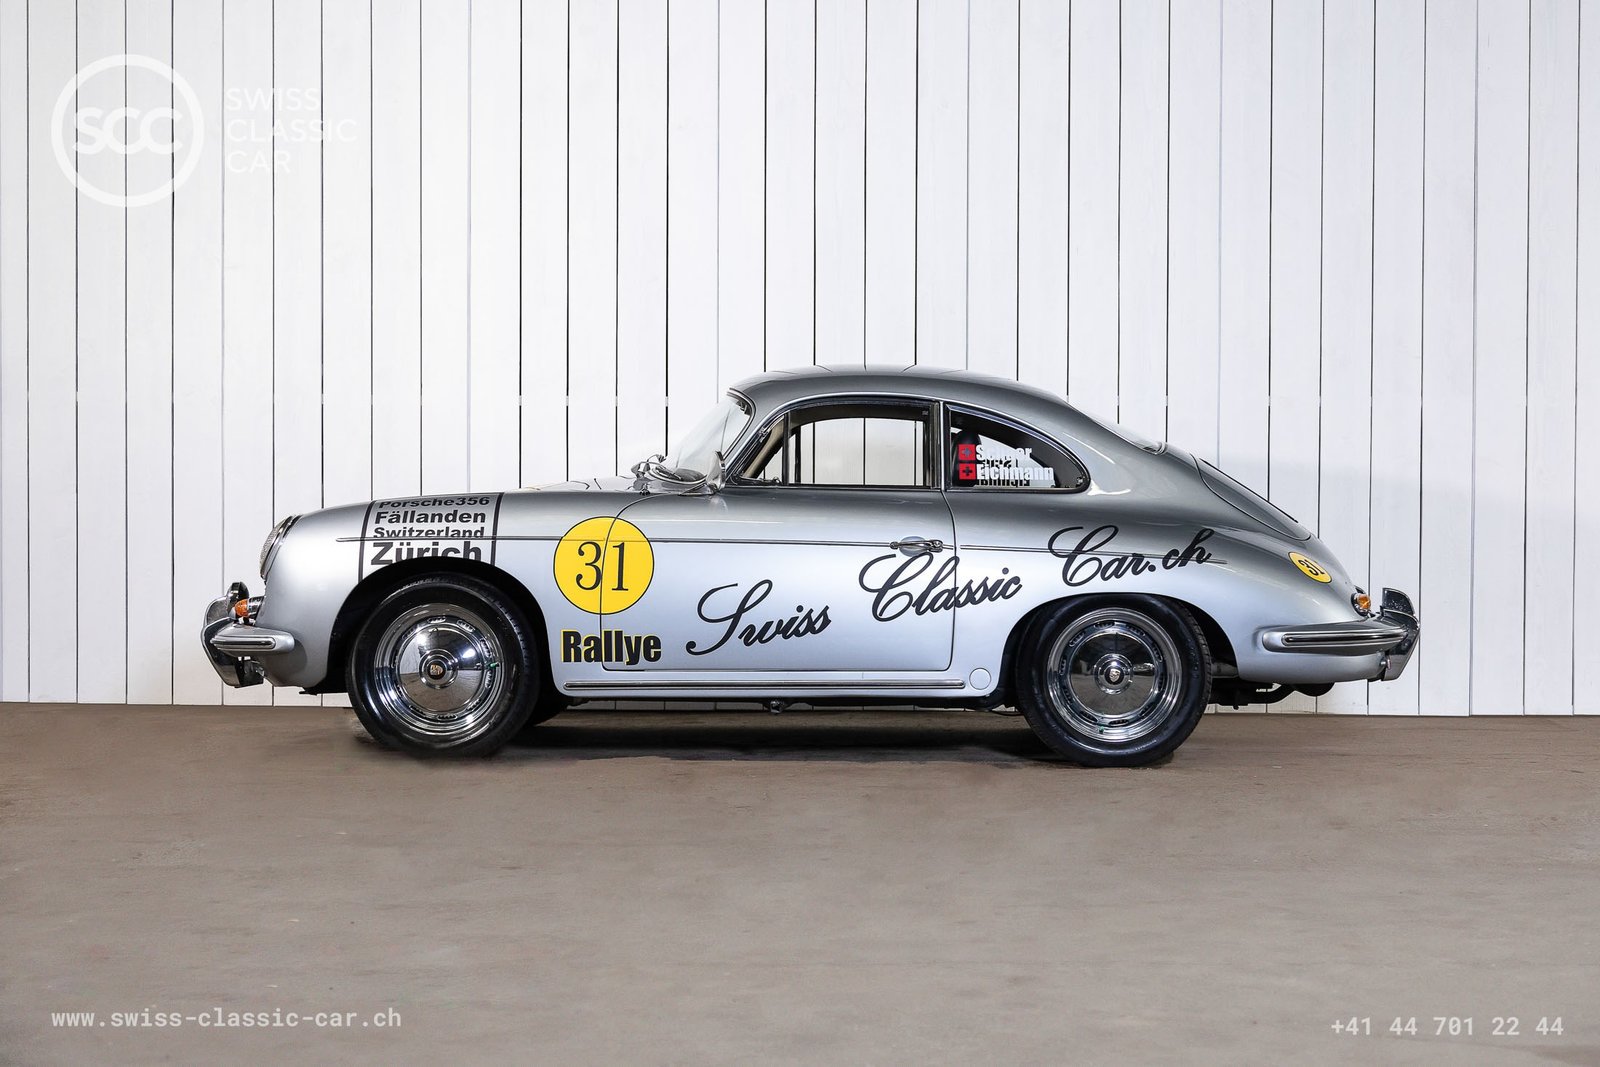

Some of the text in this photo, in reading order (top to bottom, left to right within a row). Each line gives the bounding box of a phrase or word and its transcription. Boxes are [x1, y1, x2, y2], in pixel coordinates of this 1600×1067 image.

[976, 463, 1054, 480] Eichmann
[378, 497, 490, 509] Porsche356
[375, 510, 486, 524] Fällanden
[373, 526, 485, 538] Switzerland
[575, 541, 629, 591] 31
[1298, 559, 1326, 576] 31
[685, 524, 1216, 656] Swiss Classic Car.ch
[561, 629, 662, 665] Rallye
